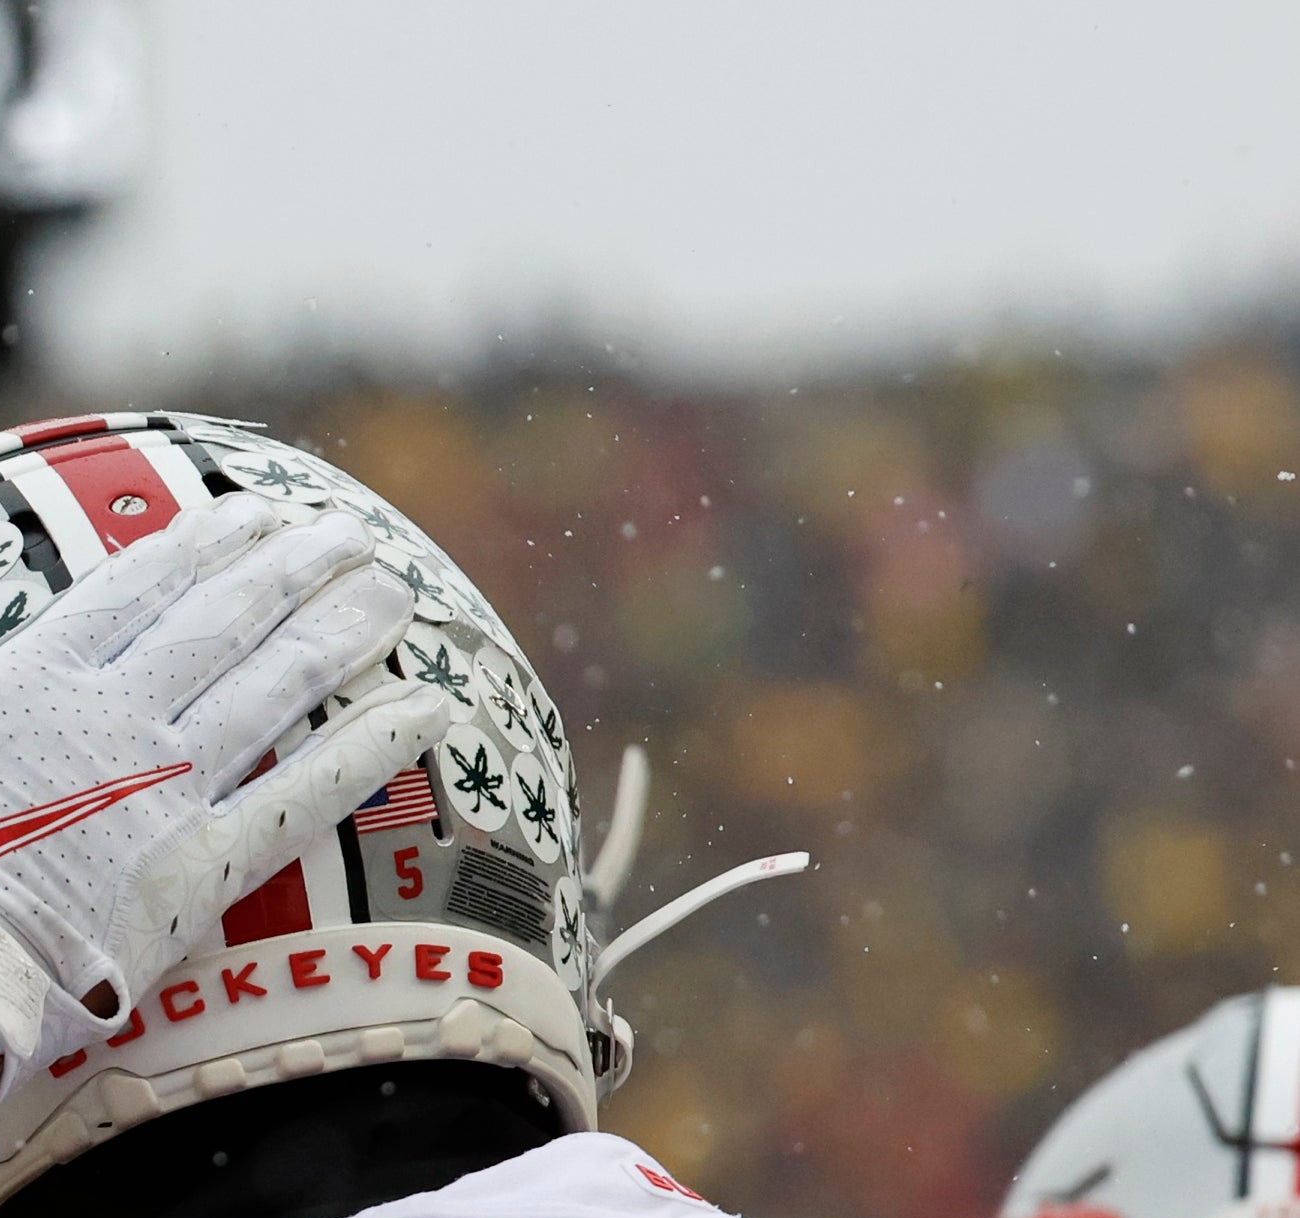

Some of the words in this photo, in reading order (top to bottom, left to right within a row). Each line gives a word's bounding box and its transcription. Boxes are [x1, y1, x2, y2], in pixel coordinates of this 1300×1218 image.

[393, 845, 425, 900] 5
[490, 838, 535, 867] WARNING
[49, 943, 504, 1078] CKEYES
